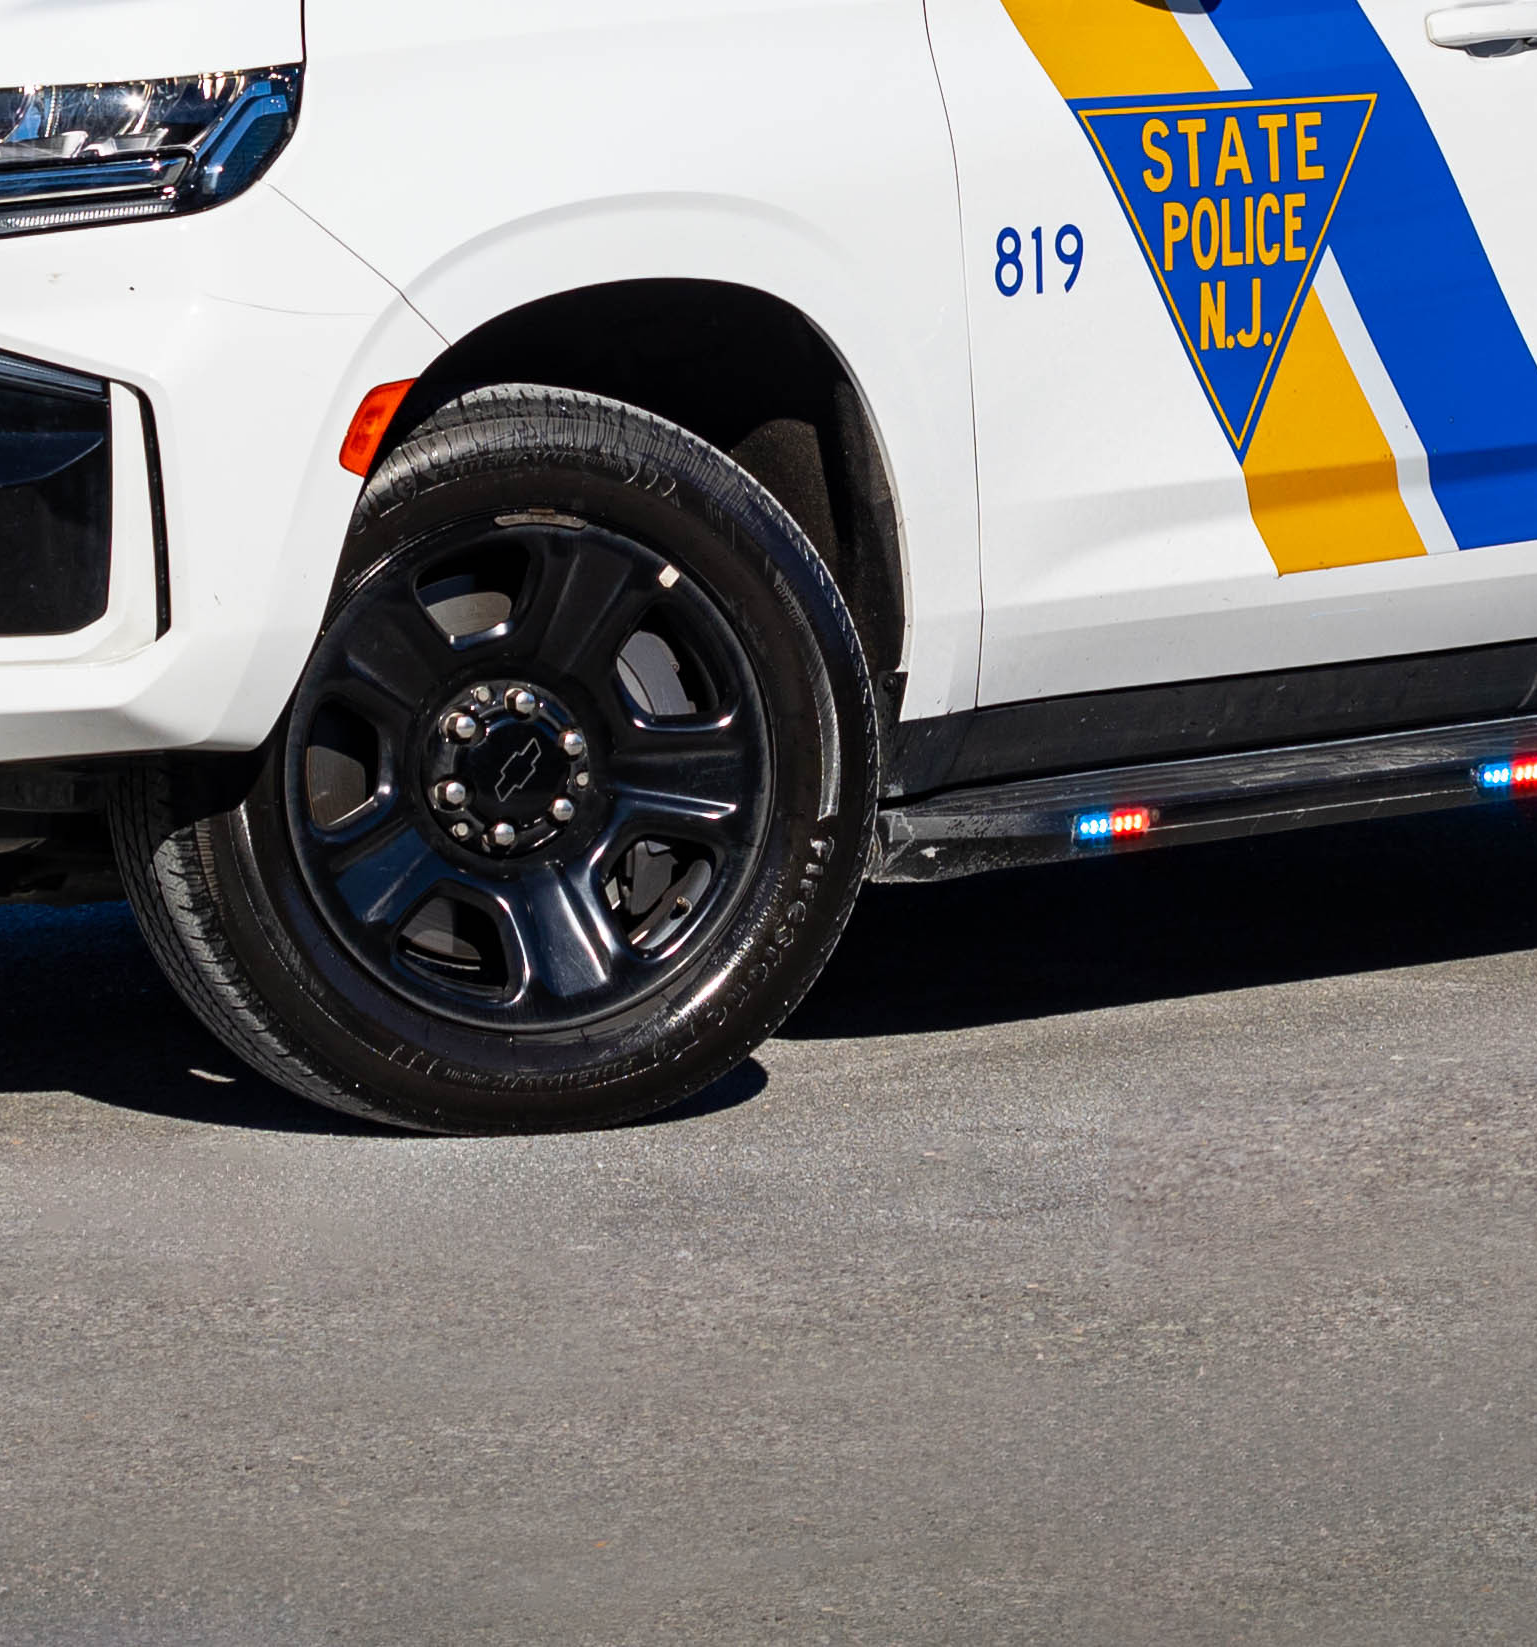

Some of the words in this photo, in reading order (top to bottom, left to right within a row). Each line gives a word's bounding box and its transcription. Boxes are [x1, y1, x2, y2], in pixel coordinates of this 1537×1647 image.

[1142, 111, 1325, 193] STATE
[994, 223, 1084, 297] 819
[1163, 192, 1307, 271] POLICE
[1200, 277, 1273, 350] N.J.
